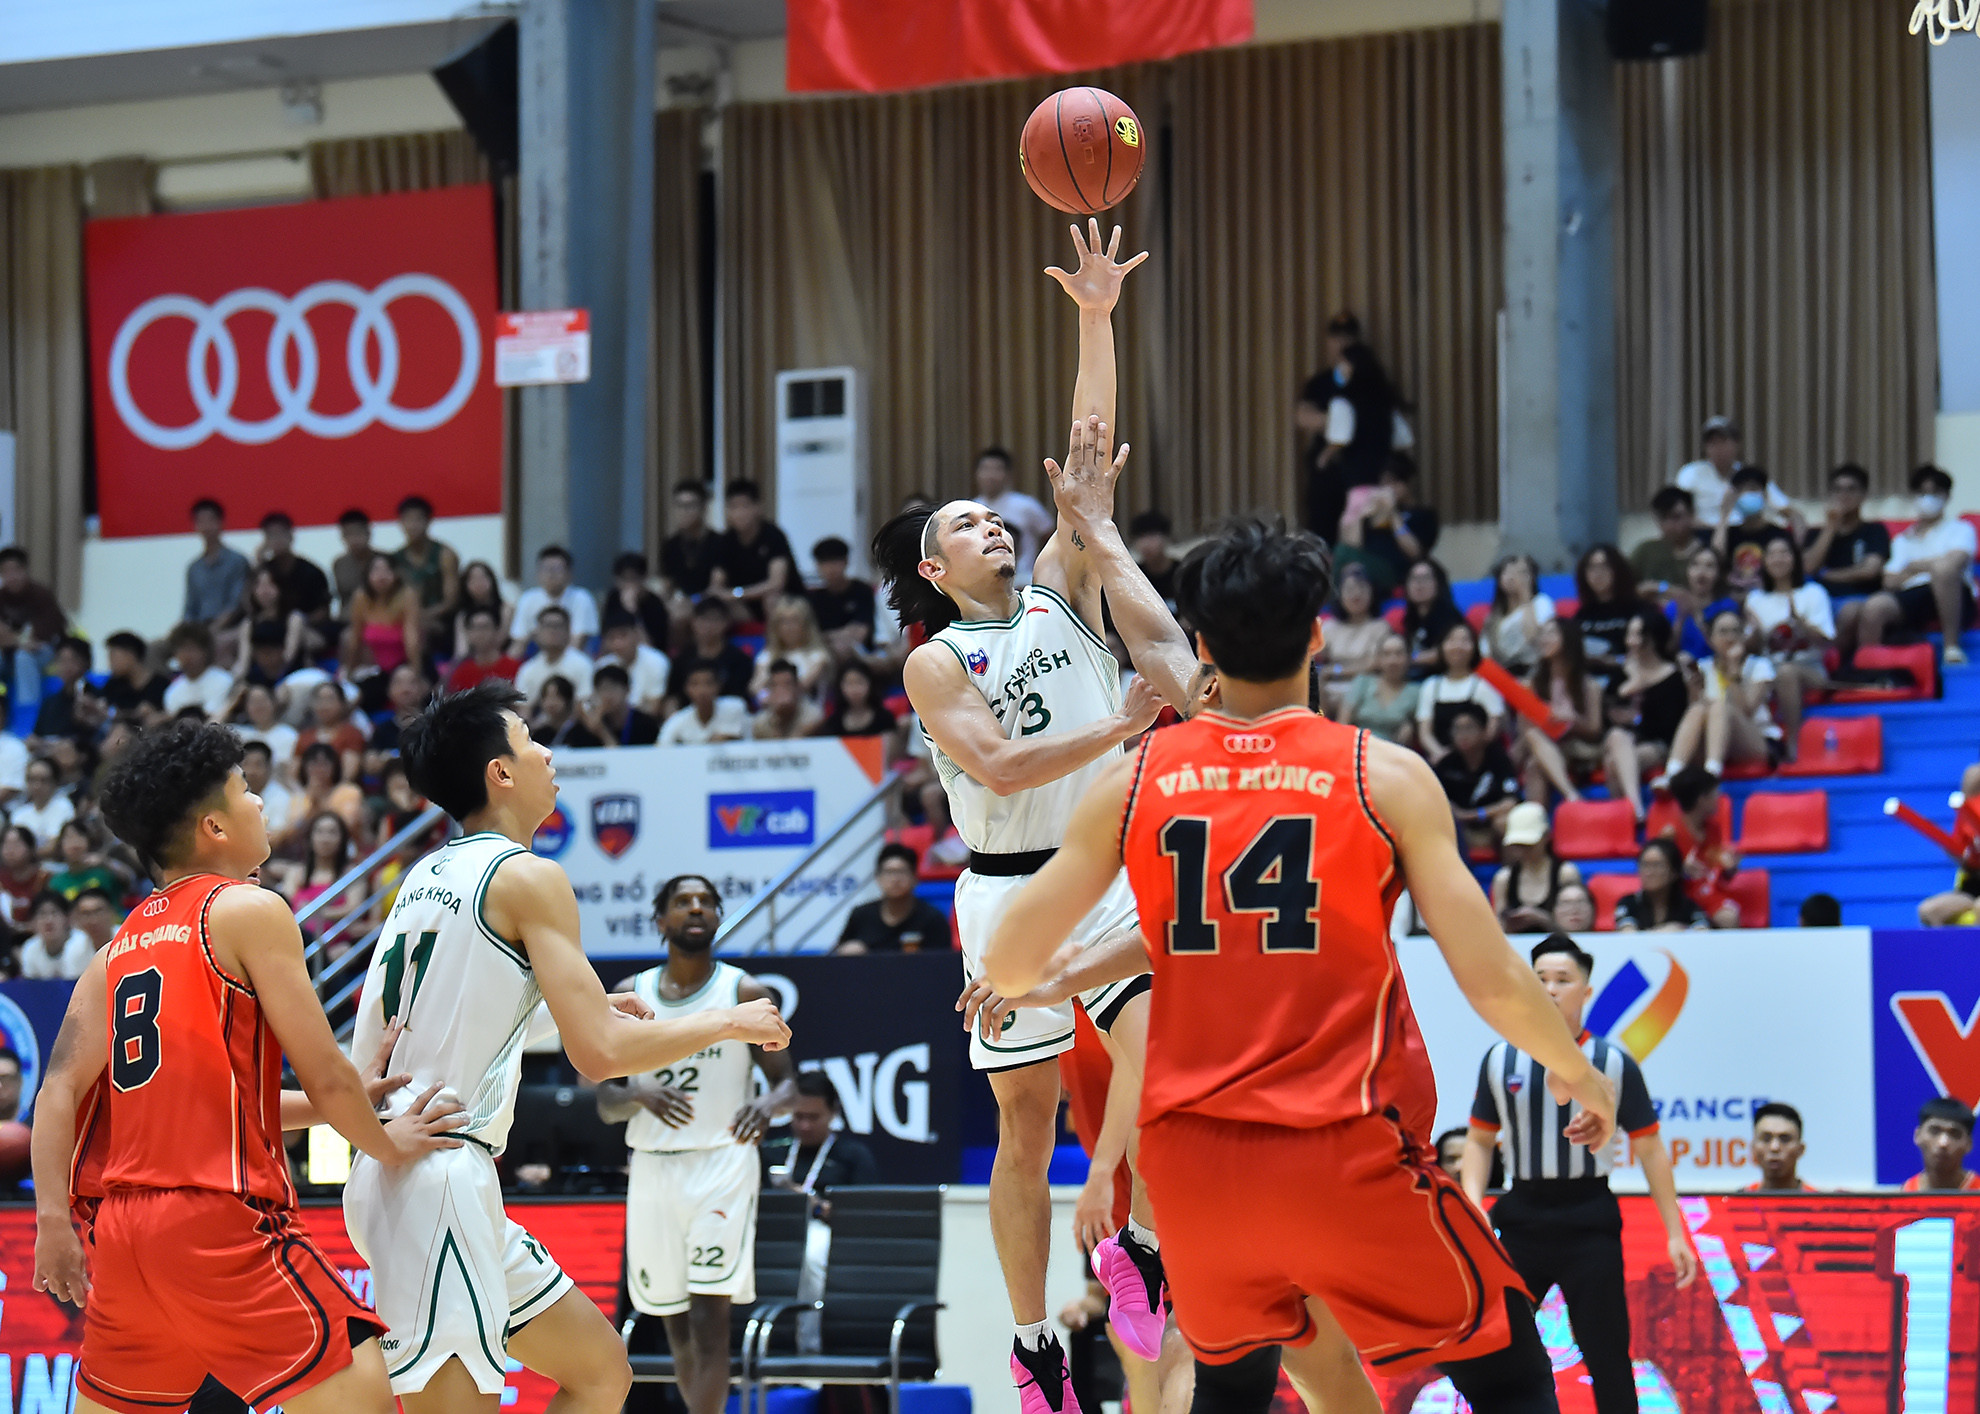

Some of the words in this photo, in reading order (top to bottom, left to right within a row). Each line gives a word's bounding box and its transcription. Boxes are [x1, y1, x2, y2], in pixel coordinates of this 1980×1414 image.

[1019, 692, 1052, 736] 3
[1156, 762, 1230, 798] VĂN
[424, 885, 463, 915] KHOA
[1159, 814, 1323, 955] 14
[139, 923, 192, 950] QUANG
[376, 929, 441, 1032] 11
[111, 965, 163, 1093] 8
[654, 1066, 699, 1092] 22
[690, 1246, 724, 1267] 22
